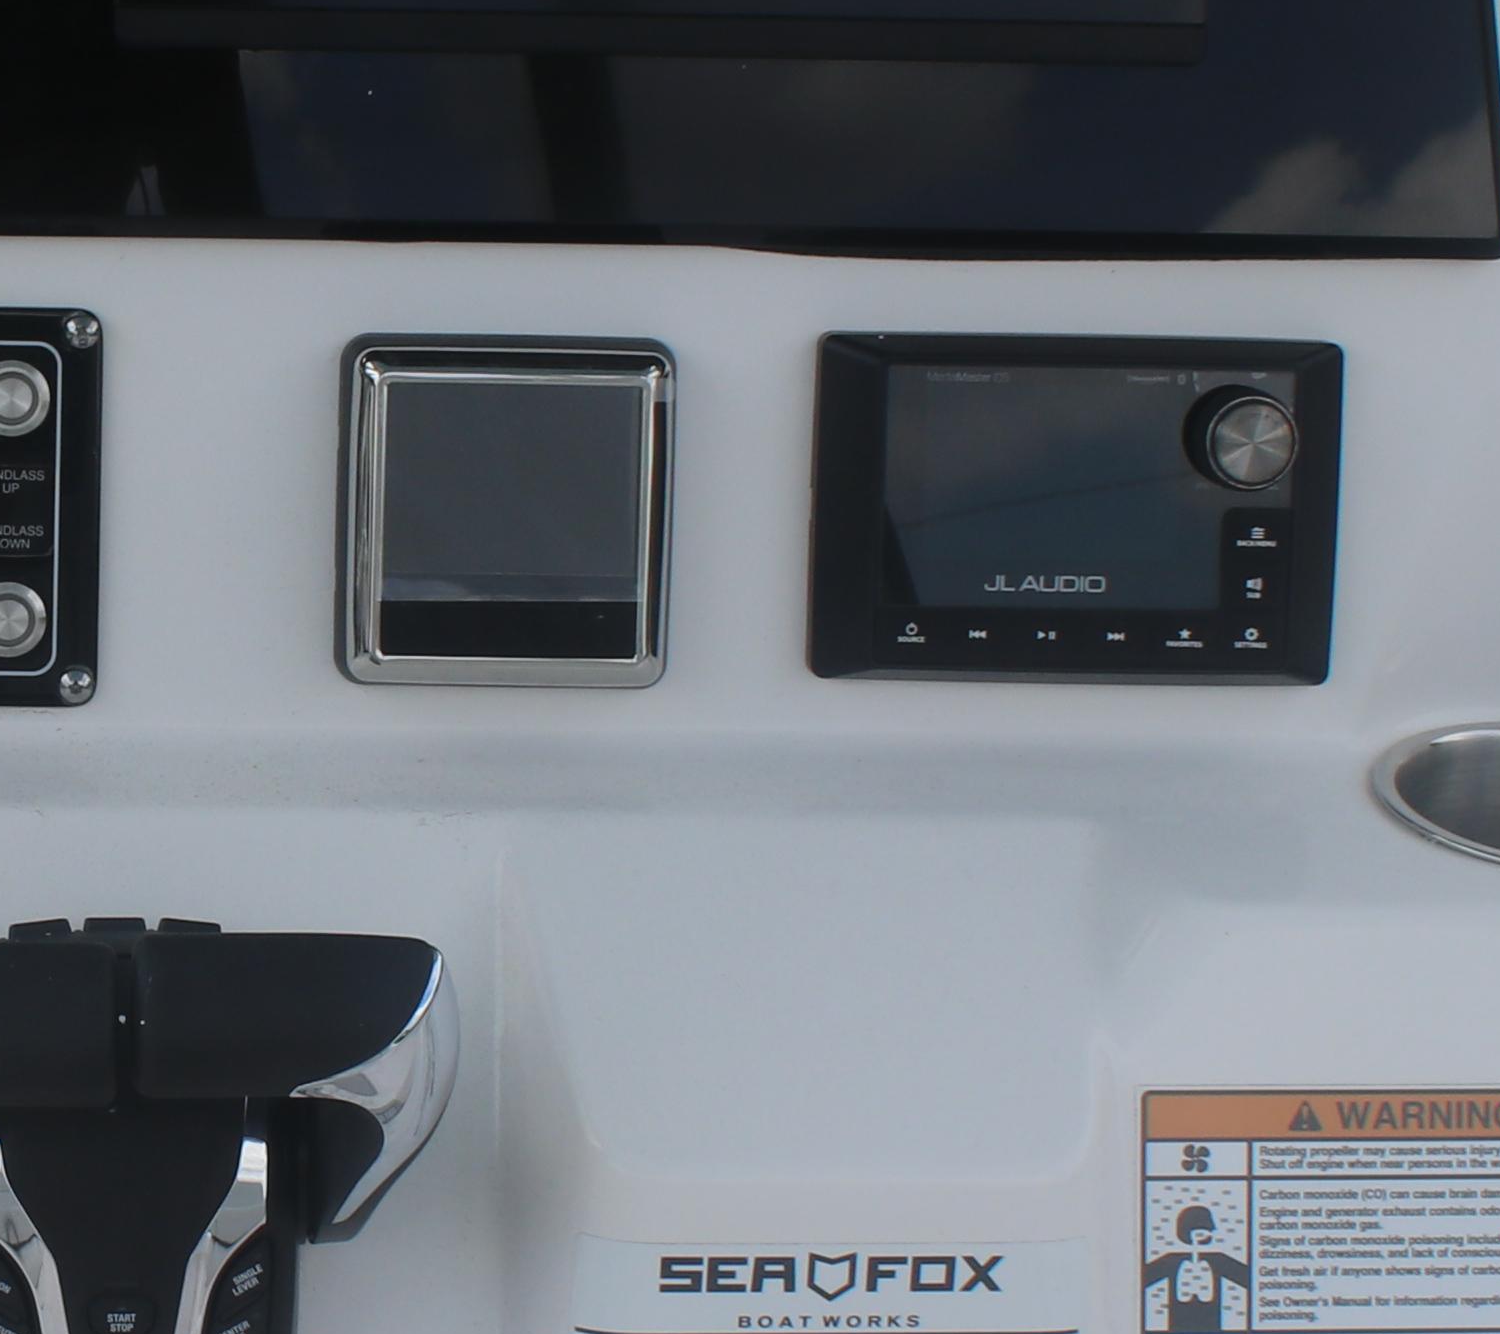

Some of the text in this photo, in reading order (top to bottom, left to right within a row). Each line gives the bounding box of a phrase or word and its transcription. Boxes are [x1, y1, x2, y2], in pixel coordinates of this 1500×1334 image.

[2, 482, 20, 493] UP
[984, 575, 1105, 592] JL AUDIO
[897, 635, 925, 643] SOURCE
[1259, 1145, 1307, 1159] Rotating
[1309, 1145, 1360, 1158] propeller
[1362, 1147, 1386, 1158] may
[1388, 1147, 1422, 1155] cause
[1425, 1146, 1467, 1155] serious
[1469, 1145, 1500, 1159] injury
[232, 1263, 264, 1286] SINGLE
[659, 1255, 1002, 1292] SEA FOX
[231, 1276, 260, 1297] LEVER
[107, 1313, 136, 1324] START
[738, 1315, 919, 1328] BOAT WORKS
[110, 1323, 133, 1332] STOP
